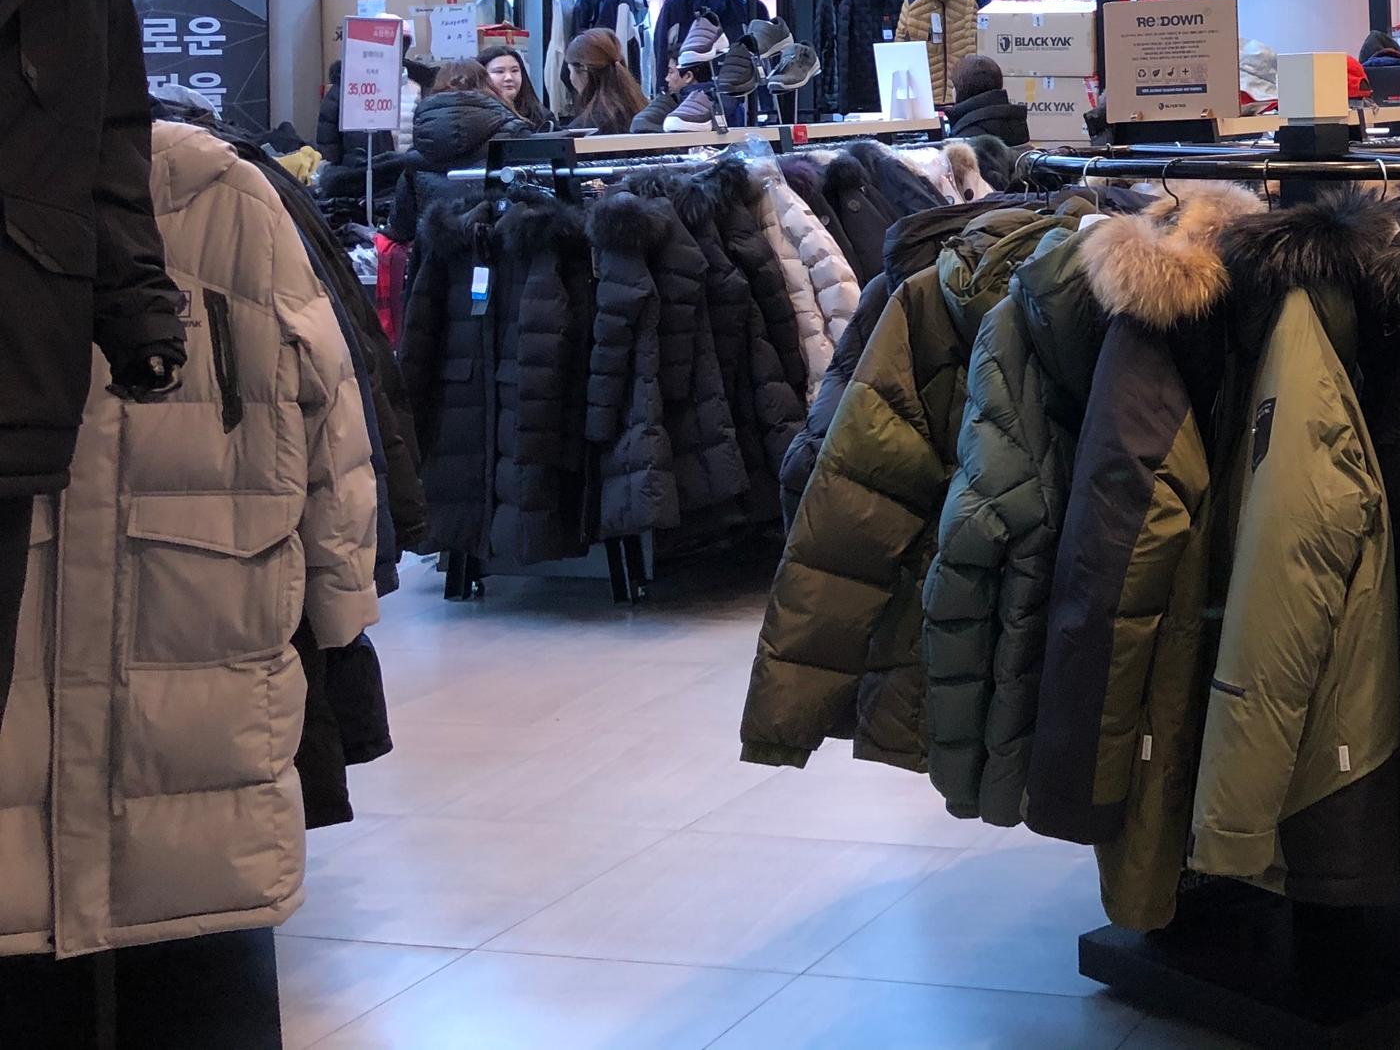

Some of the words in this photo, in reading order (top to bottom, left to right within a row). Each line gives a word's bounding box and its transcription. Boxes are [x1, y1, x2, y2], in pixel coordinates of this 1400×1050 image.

[1014, 37, 1049, 47] BLACK
[1050, 36, 1072, 47] YAK
[348, 83, 377, 96] 35,000
[364, 99, 393, 112] 92,000
[1053, 101, 1075, 112] YAK
